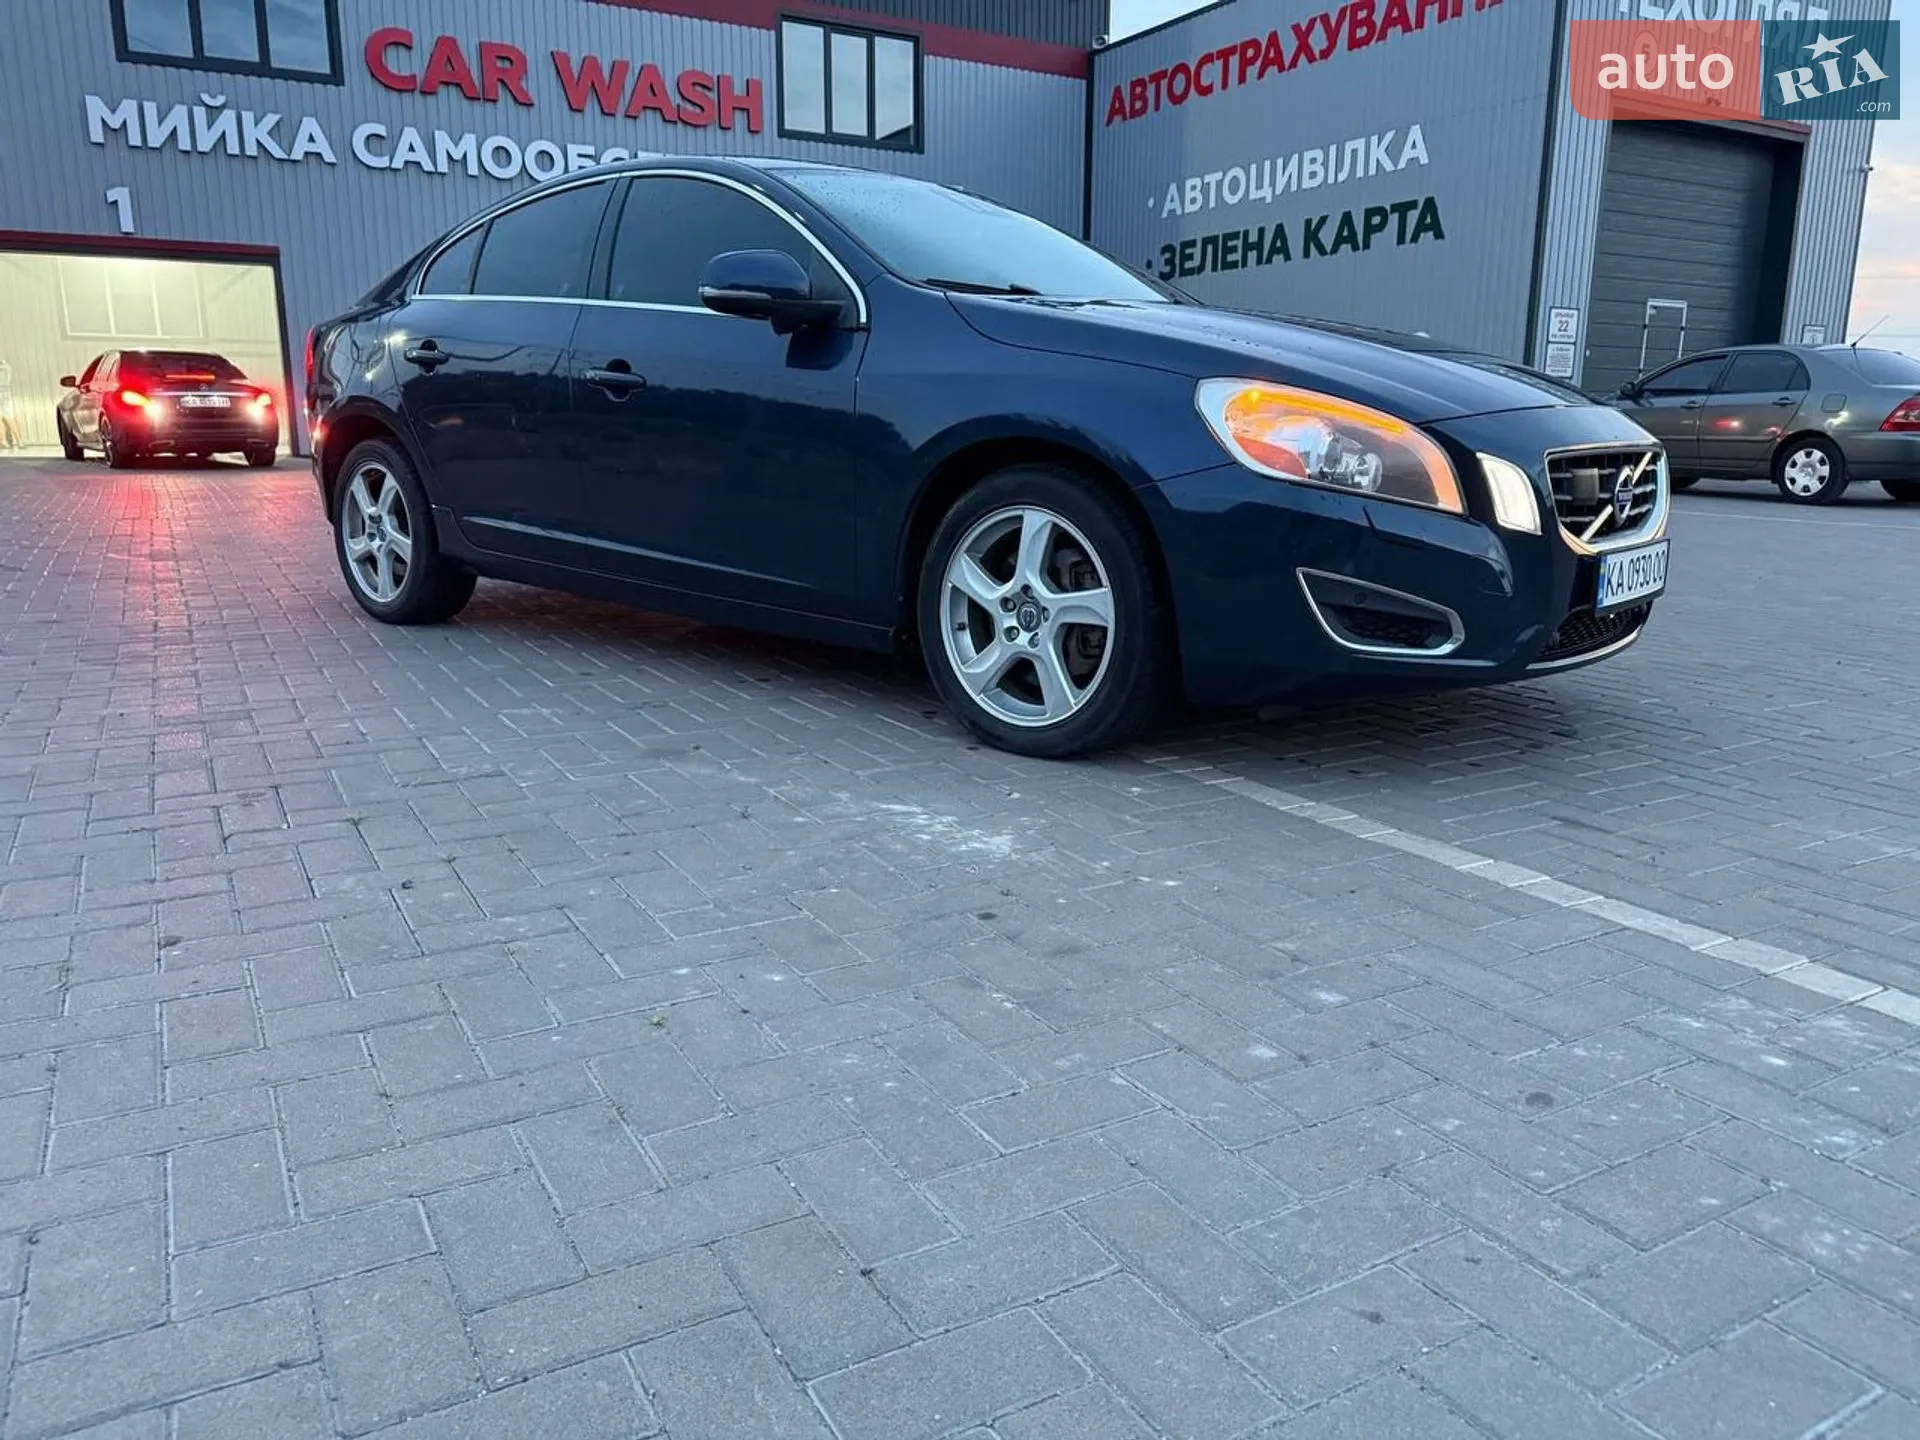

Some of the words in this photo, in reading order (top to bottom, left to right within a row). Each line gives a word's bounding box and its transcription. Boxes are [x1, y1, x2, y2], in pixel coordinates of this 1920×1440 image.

[364, 26, 534, 106] CAR
[551, 50, 763, 133] WASH
[1105, 0, 1503, 128] АВТОСТРАХУВАН
[84, 92, 338, 165] МИЙКА
[1161, 123, 1430, 218] АВТОЦИВІЛКА
[106, 186, 135, 234] 1
[1158, 222, 1292, 281] ЗЕЛЕНА
[1302, 196, 1446, 259] КАРТА
[1605, 560, 1625, 598] KA
